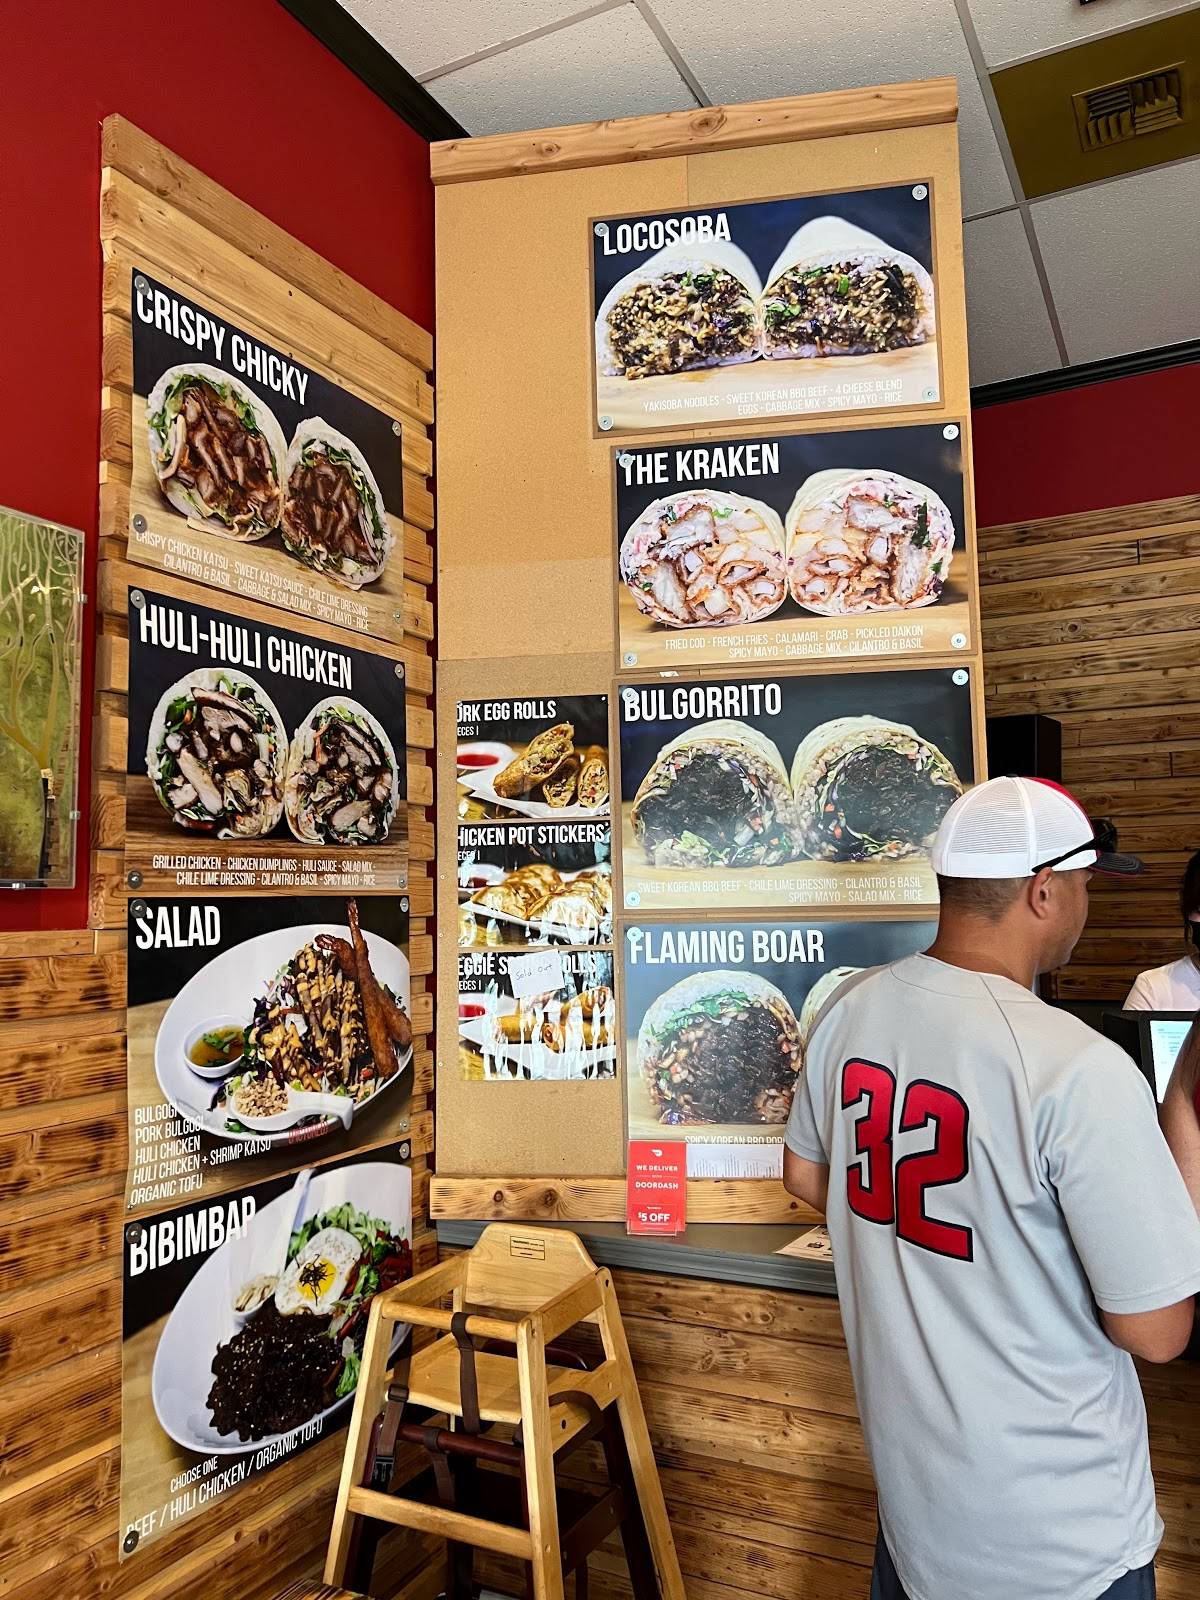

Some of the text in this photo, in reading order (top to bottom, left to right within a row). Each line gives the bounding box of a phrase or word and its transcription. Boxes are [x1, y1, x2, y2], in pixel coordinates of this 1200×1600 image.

[602, 213, 731, 255] LOCOSOBA
[136, 287, 308, 405] CRISPY CHICKY
[644, 399, 682, 412] YAKISOBA
[685, 395, 719, 407] NOODLES
[727, 392, 754, 404] SWEET
[756, 389, 788, 401] KOREAN
[808, 386, 828, 396] BEEF
[843, 382, 873, 394] CHEESE
[876, 379, 903, 391] BLEND
[766, 400, 803, 412] CABBAGE
[805, 398, 820, 409] MIX
[827, 396, 852, 407] SPICY
[853, 394, 877, 405] MAYO
[885, 391, 903, 402] RICE
[625, 443, 780, 486] THE KRAKEN
[136, 532, 368, 617] CRISPY CHICKEN KATSU SWEET KATSU SAUCE CHILE LIME DRESSING
[164, 554, 368, 630] CILANTRO & BASIL CABBAGE & SALAD MIX SPICY MAYO RICE
[140, 603, 352, 690] HULI-HULI CHICKEN
[666, 625, 923, 649] FRIED COD FRENCH FRIES CALAMARI CRAB PICKLED DAIKON
[729, 638, 924, 658] SPICY MAYO CABBAGE MIX CILANTRO & BASIL
[484, 702, 510, 720] EGG
[514, 700, 556, 719] ROLLS
[624, 683, 781, 722] BULGORRITO
[509, 827, 535, 844] POT
[538, 824, 605, 844] STICKERS
[153, 855, 372, 872] GRILLED CHICKEN CHICKEN DUMPLINGS HULI SAUCE SALAD MIX
[177, 872, 376, 886] CHILE LIME DRESSING CILANTRO & BASIL SPICY MAYO RICE
[721, 880, 742, 891] BEEF
[750, 880, 773, 891] CHILE
[775, 879, 794, 890] LIME
[797, 878, 837, 890] DRESSING
[846, 877, 887, 888] CILANTRO
[889, 877, 895, 888] &
[898, 877, 922, 888] BASIL
[789, 889, 922, 902] SPICY MAYO SALAD MIX RICE
[136, 905, 221, 949] SALAD
[630, 930, 824, 964] FLAMING BOAR
[135, 1104, 177, 1125] BULGOGI
[136, 1124, 162, 1145] PORK
[136, 1135, 200, 1165] HULI CHICKEN
[766, 1136, 784, 1144] POR
[133, 1165, 156, 1185] HULI
[159, 1154, 200, 1178] CHICKEN
[210, 1143, 243, 1165] SHRIMP
[244, 1138, 271, 1157] KATSU
[842, 1058, 974, 1262] 32
[131, 1173, 203, 1205] ORGANIC TOFU
[638, 1212, 670, 1222] $5 OFF
[130, 1196, 256, 1276] BIBIMBAP
[170, 1488, 196, 1520] HULI
[199, 1461, 245, 1503] CHICKEN
[256, 1433, 298, 1470] ORGANIC
[300, 1418, 322, 1443] TOFU
[171, 1456, 218, 1493] CHOOSE ONE
